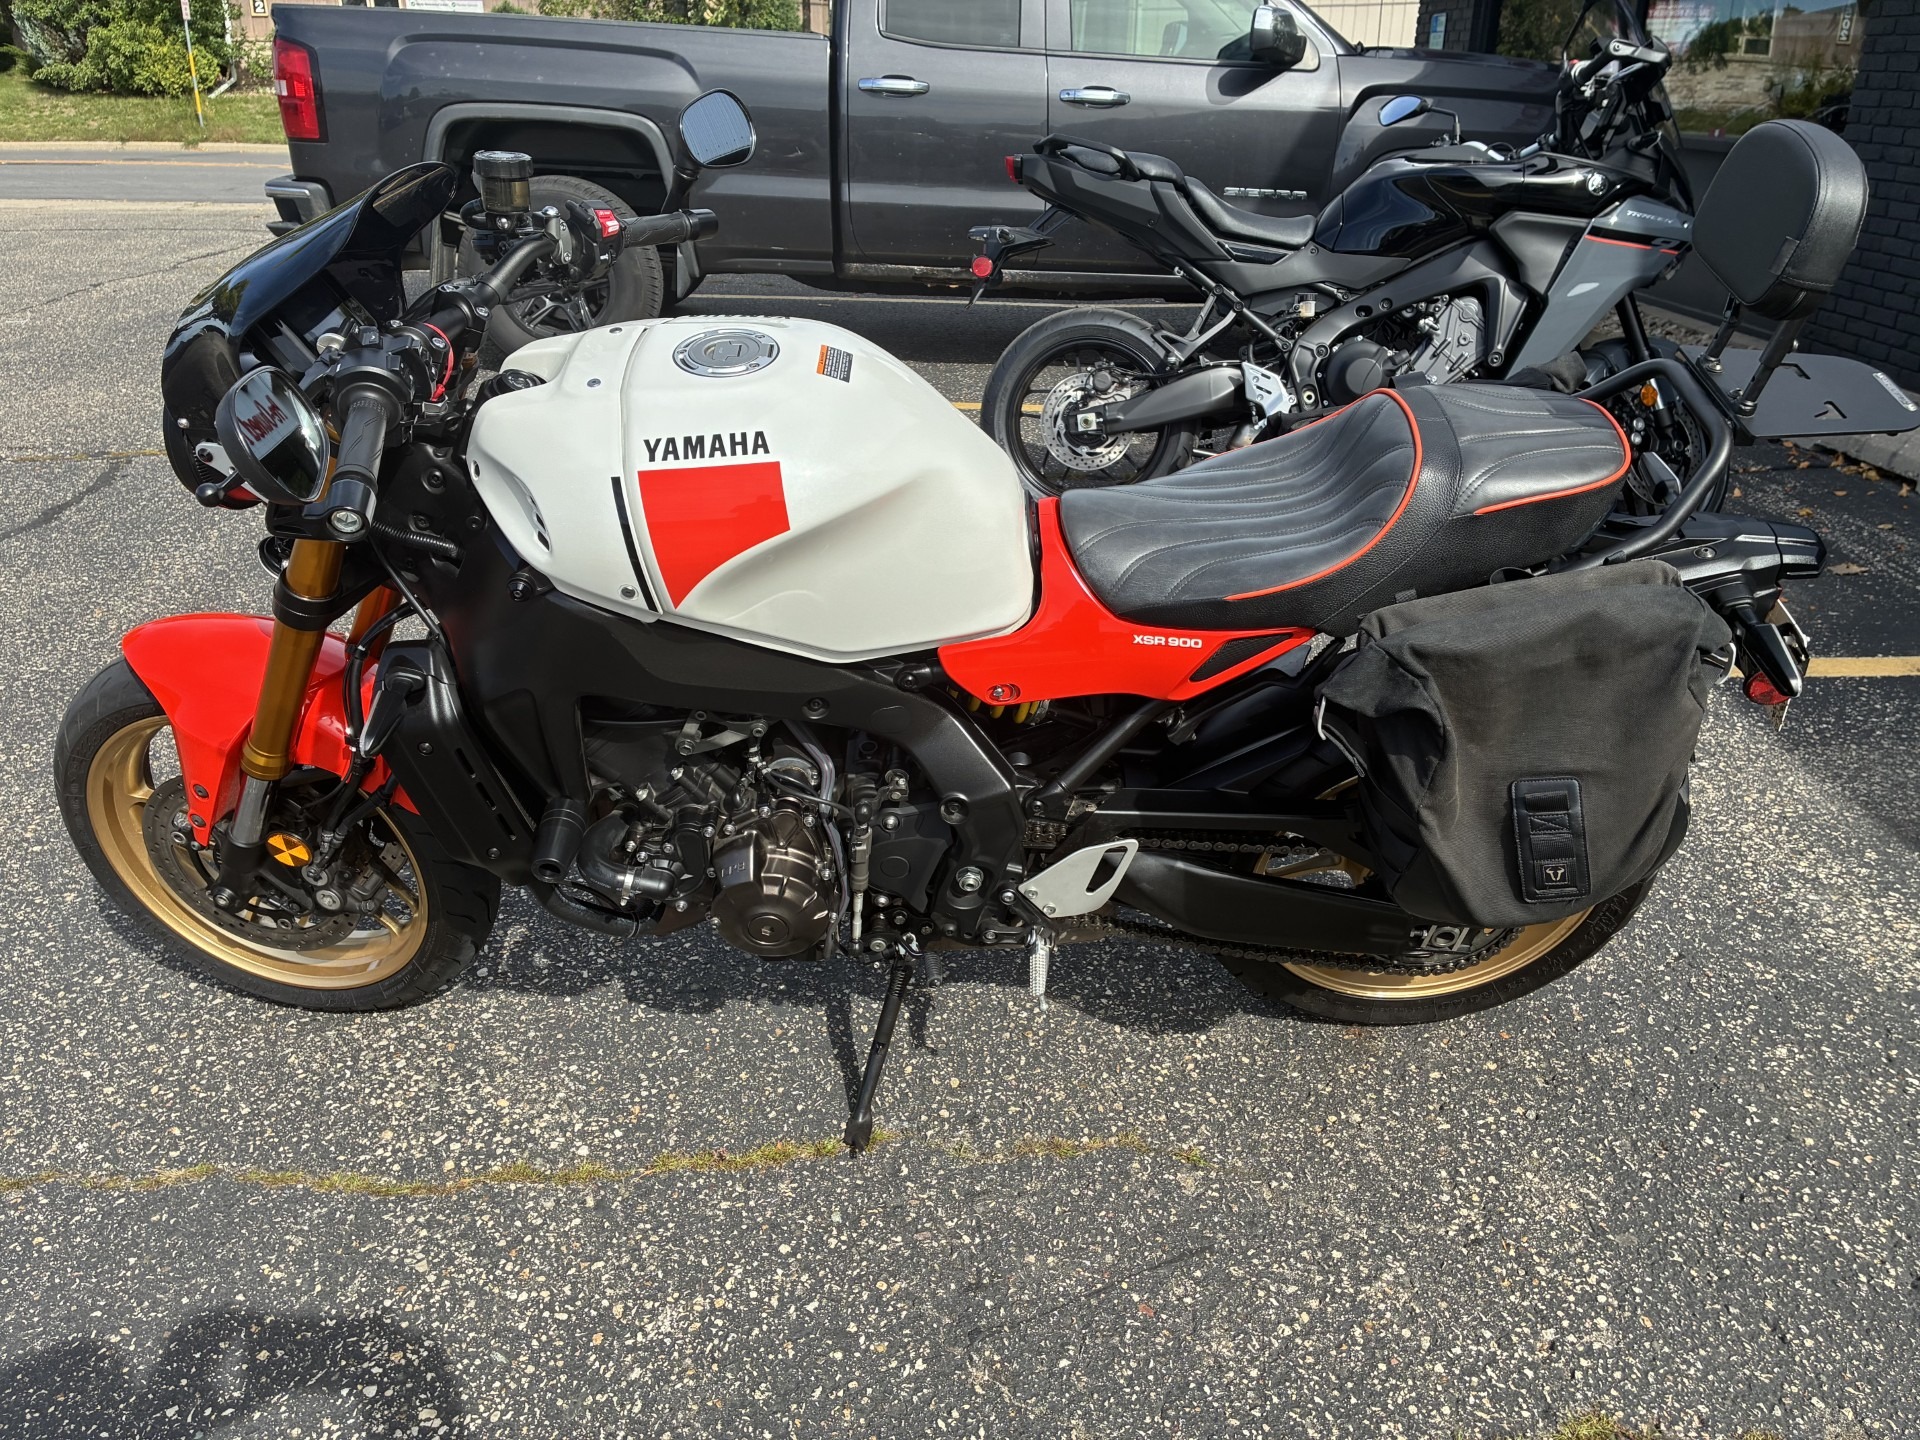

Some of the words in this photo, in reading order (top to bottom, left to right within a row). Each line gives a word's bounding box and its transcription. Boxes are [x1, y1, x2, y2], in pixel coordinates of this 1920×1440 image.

[254, 0, 265, 13] 2
[643, 430, 770, 462] YAMAHA
[1132, 634, 1166, 646] XSR
[1167, 636, 1203, 649] 900
